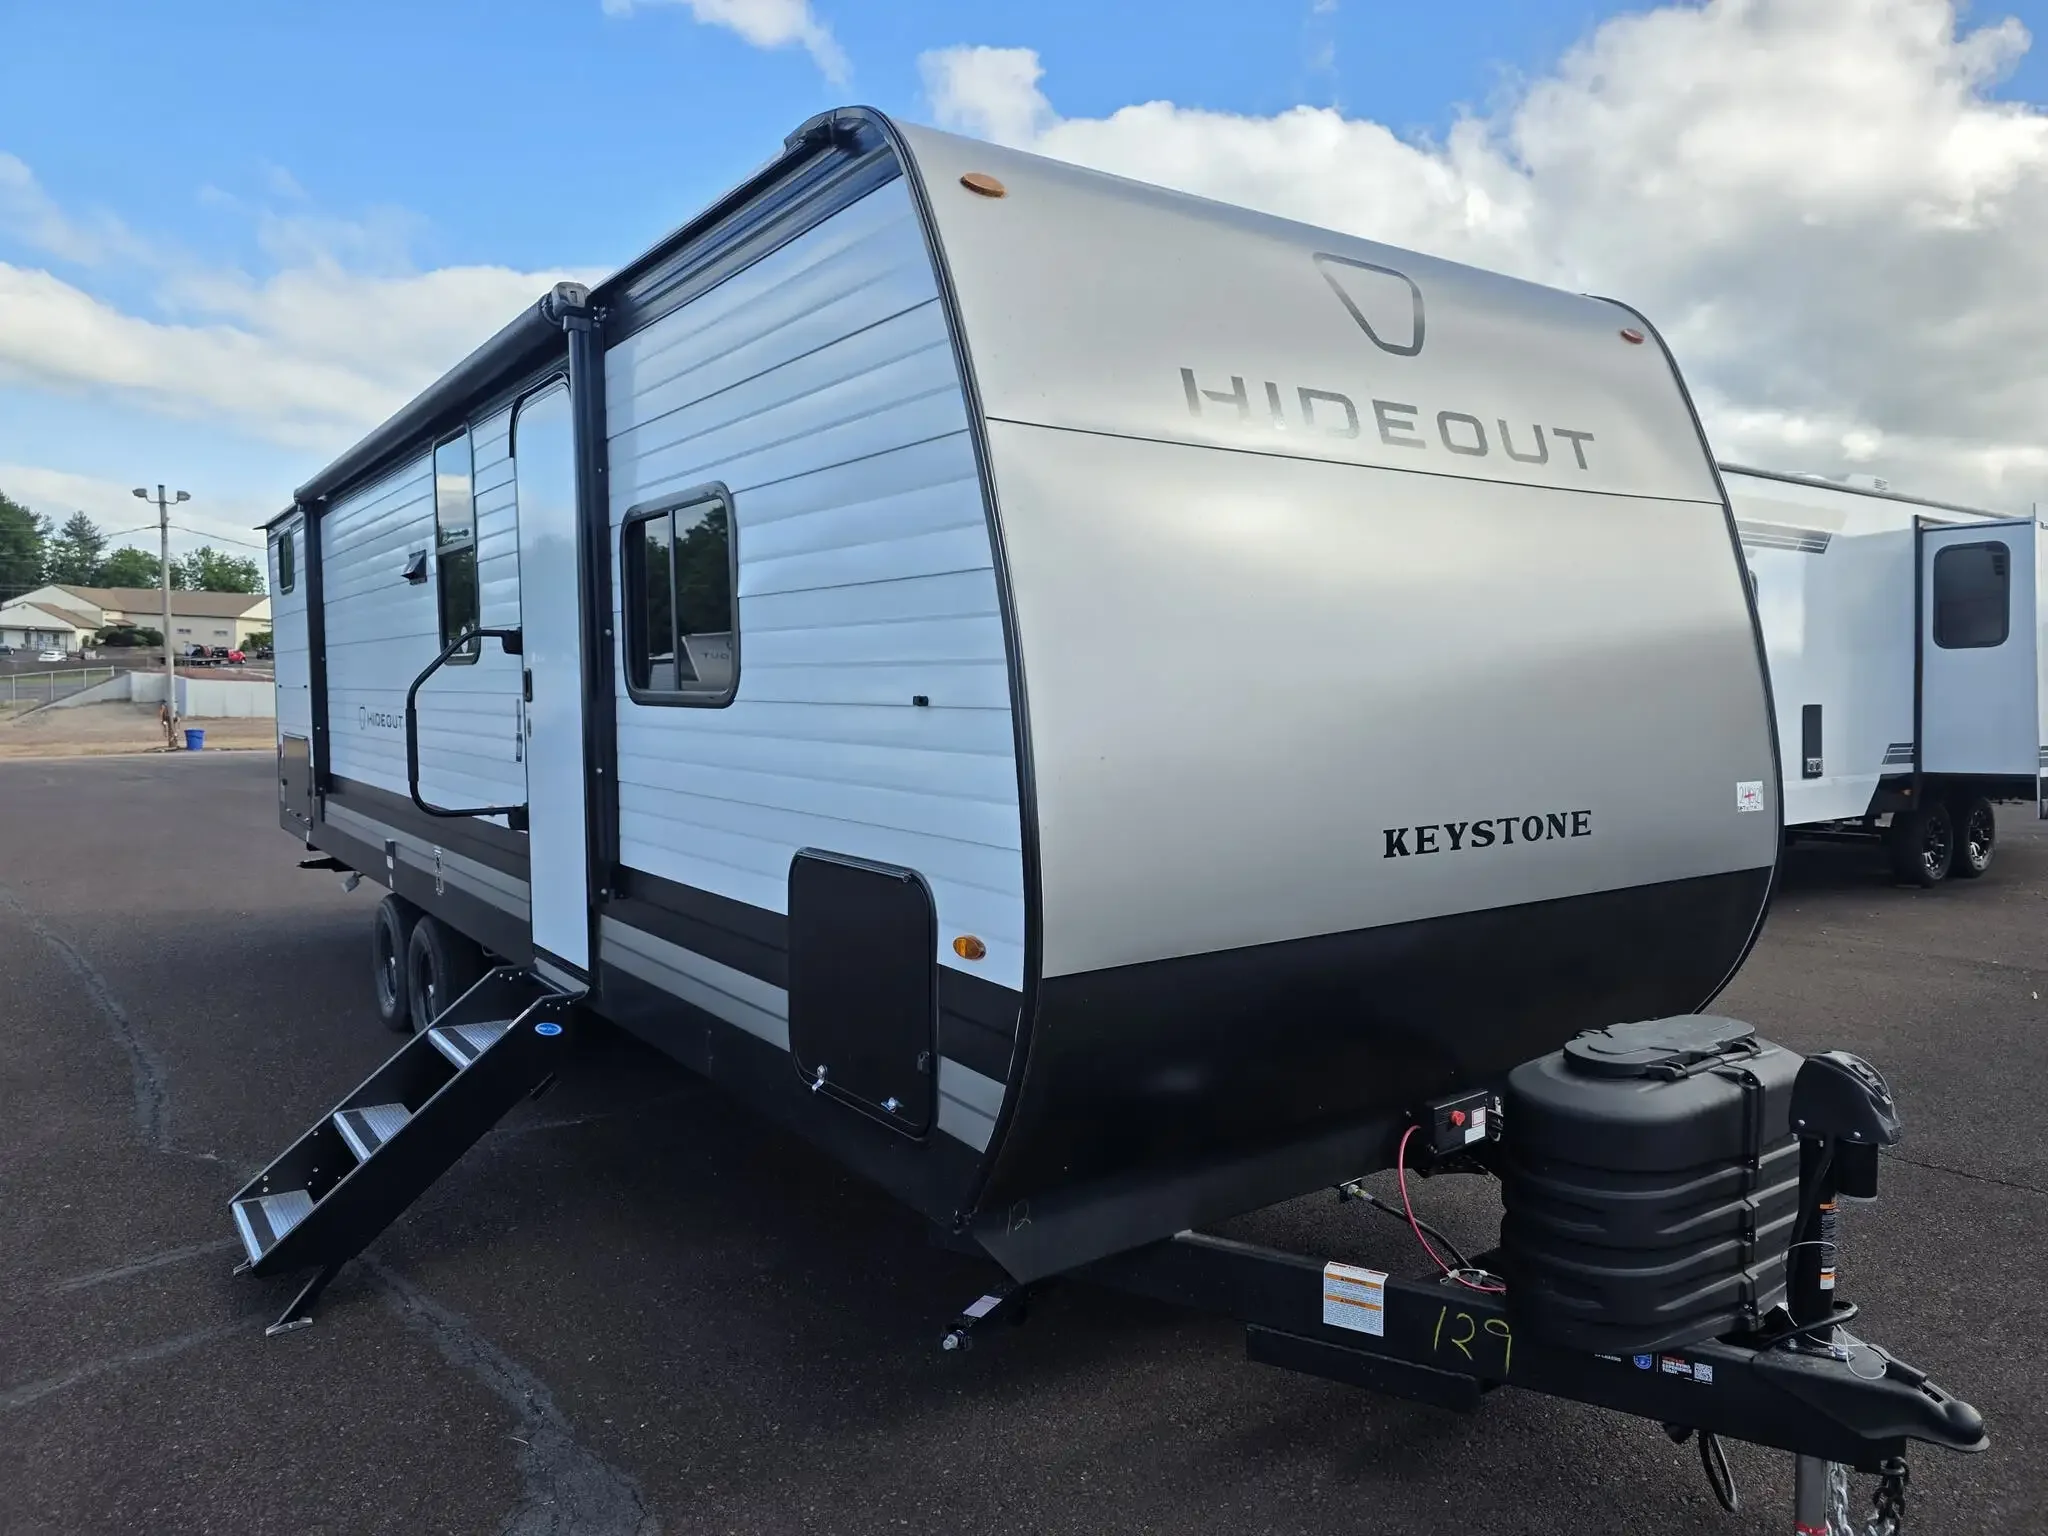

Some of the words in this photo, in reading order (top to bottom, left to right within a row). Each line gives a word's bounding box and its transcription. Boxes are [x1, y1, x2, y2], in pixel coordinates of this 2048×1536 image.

[1180, 367, 1595, 470] HIDEOUT
[367, 712, 403, 729] HIDEOUT
[1383, 810, 1592, 858] KEYSTONE
[1434, 1305, 1512, 1377] 129
